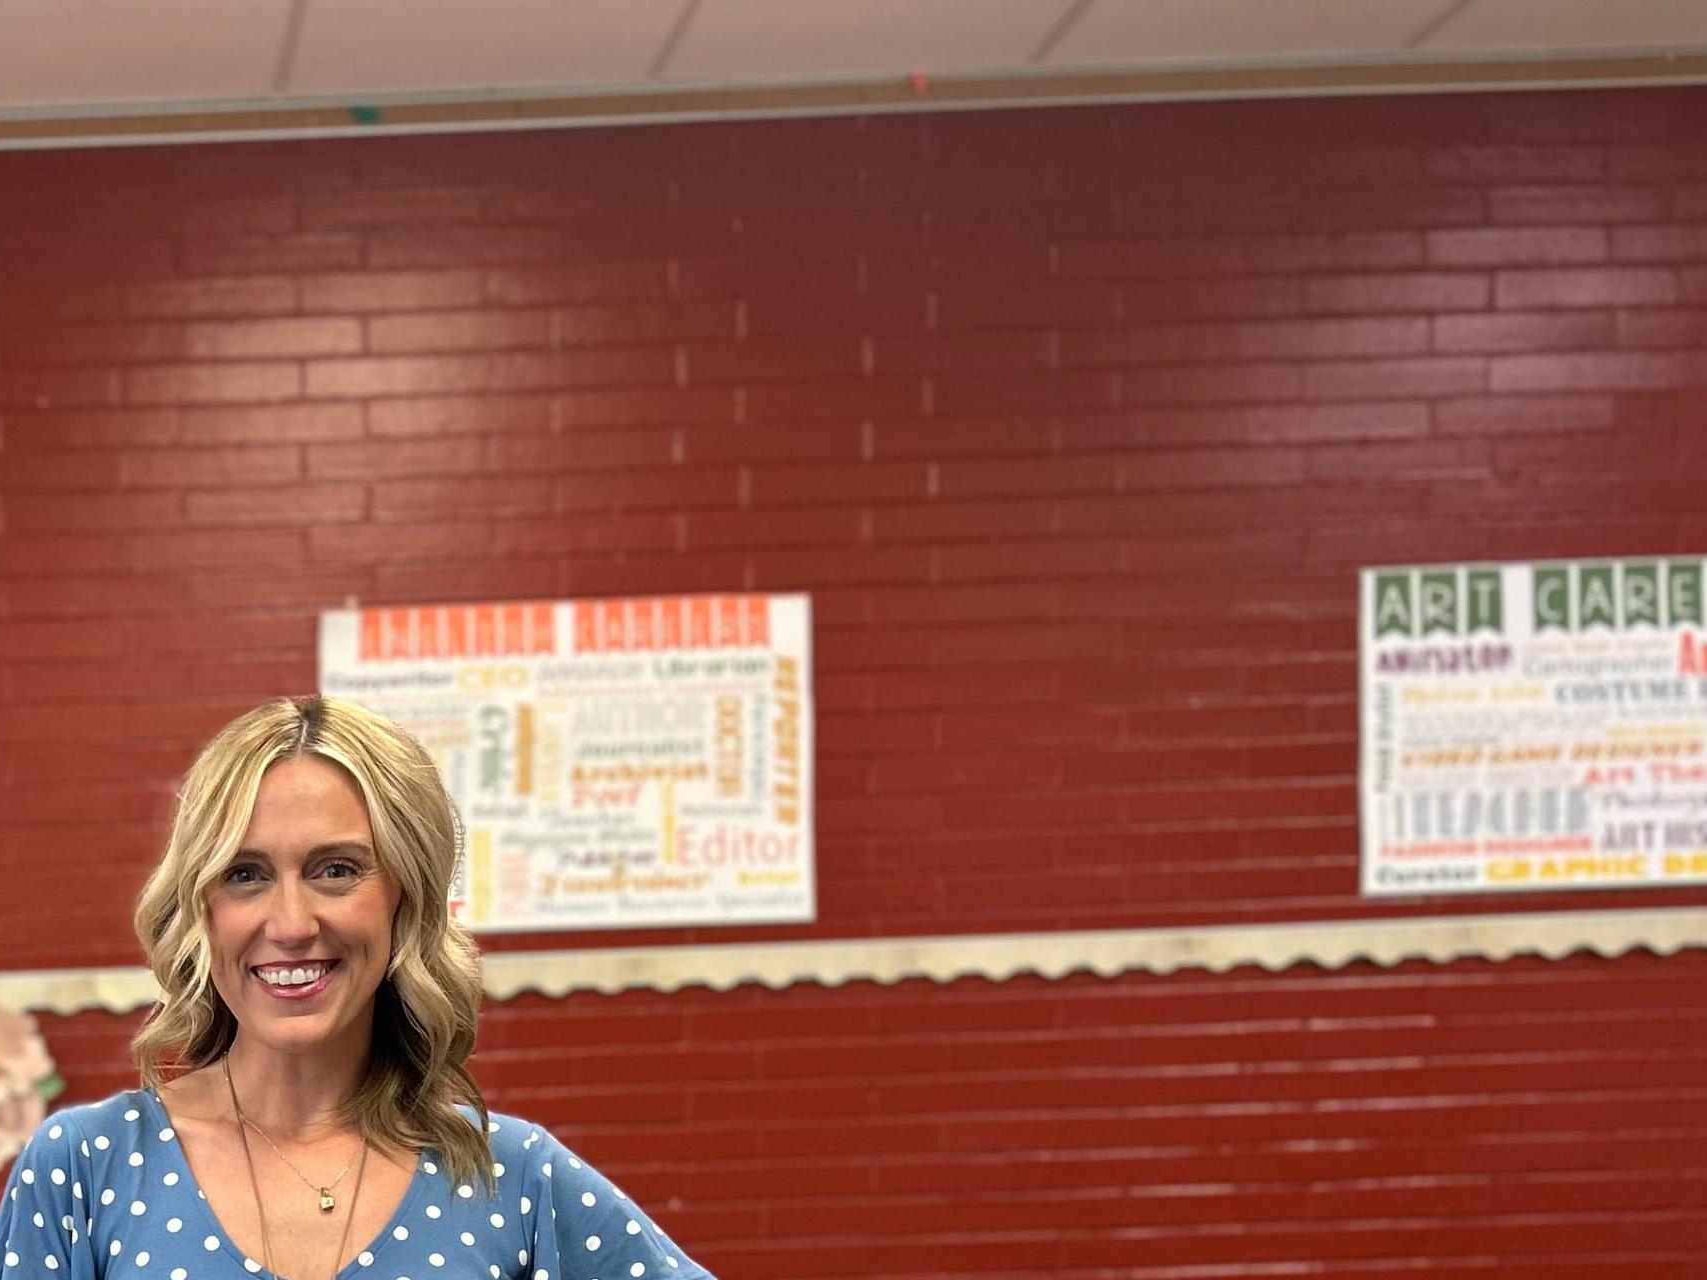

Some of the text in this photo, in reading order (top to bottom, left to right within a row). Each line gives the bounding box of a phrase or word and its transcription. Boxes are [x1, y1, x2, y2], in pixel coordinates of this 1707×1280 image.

[1377, 579, 1496, 626] ART
[458, 664, 529, 689] CEO
[653, 655, 770, 679] Librarian
[677, 825, 800, 867] Editor
